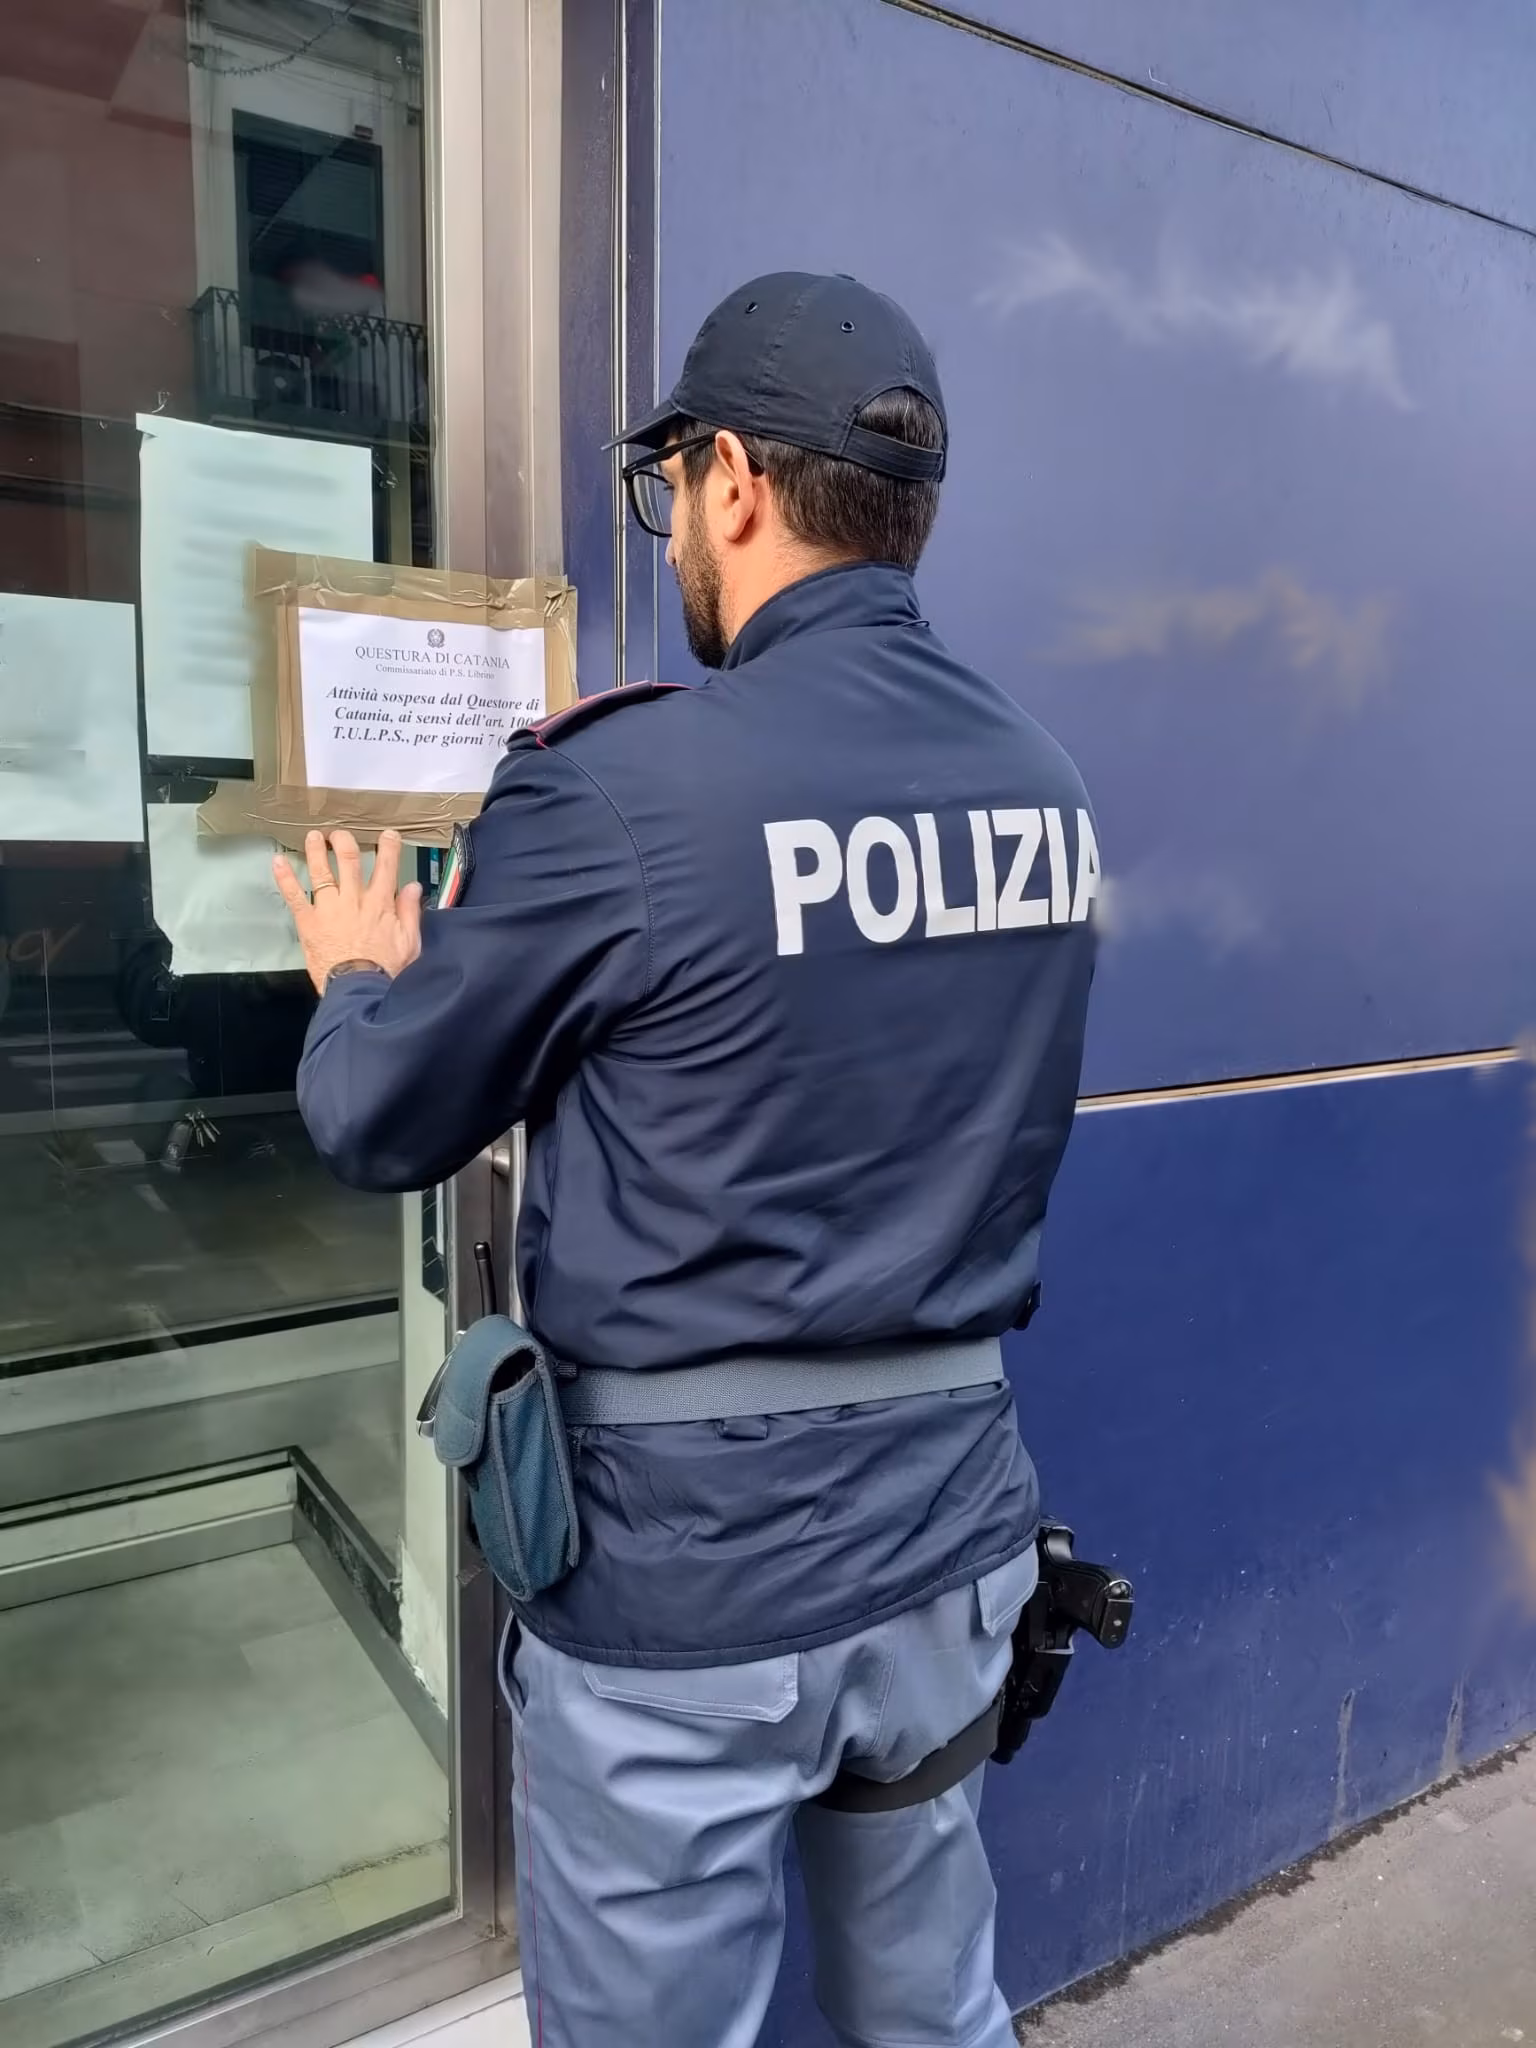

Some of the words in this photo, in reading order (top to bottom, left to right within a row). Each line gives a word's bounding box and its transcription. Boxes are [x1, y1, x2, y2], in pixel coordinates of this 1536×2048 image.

[355, 646, 431, 663] QUESTURA
[435, 652, 450, 664] DI
[453, 653, 510, 669] CATANIA
[375, 664, 437, 676] Commissariato
[438, 668, 447, 677] di
[449, 668, 466, 678] P.S.
[326, 686, 378, 702] Attività
[381, 692, 436, 707] sospesa
[440, 692, 463, 706] dal
[466, 693, 522, 710] Questore
[526, 698, 540, 711] di
[335, 706, 393, 723] Catania,
[398, 710, 413, 723] ai
[416, 712, 452, 725] sensi
[456, 713, 504, 728] dell'art.
[333, 726, 409, 744] T.U.L.P.S.,
[413, 733, 438, 746] per
[440, 732, 484, 748] giorni
[763, 807, 1101, 955] POLIZIA
